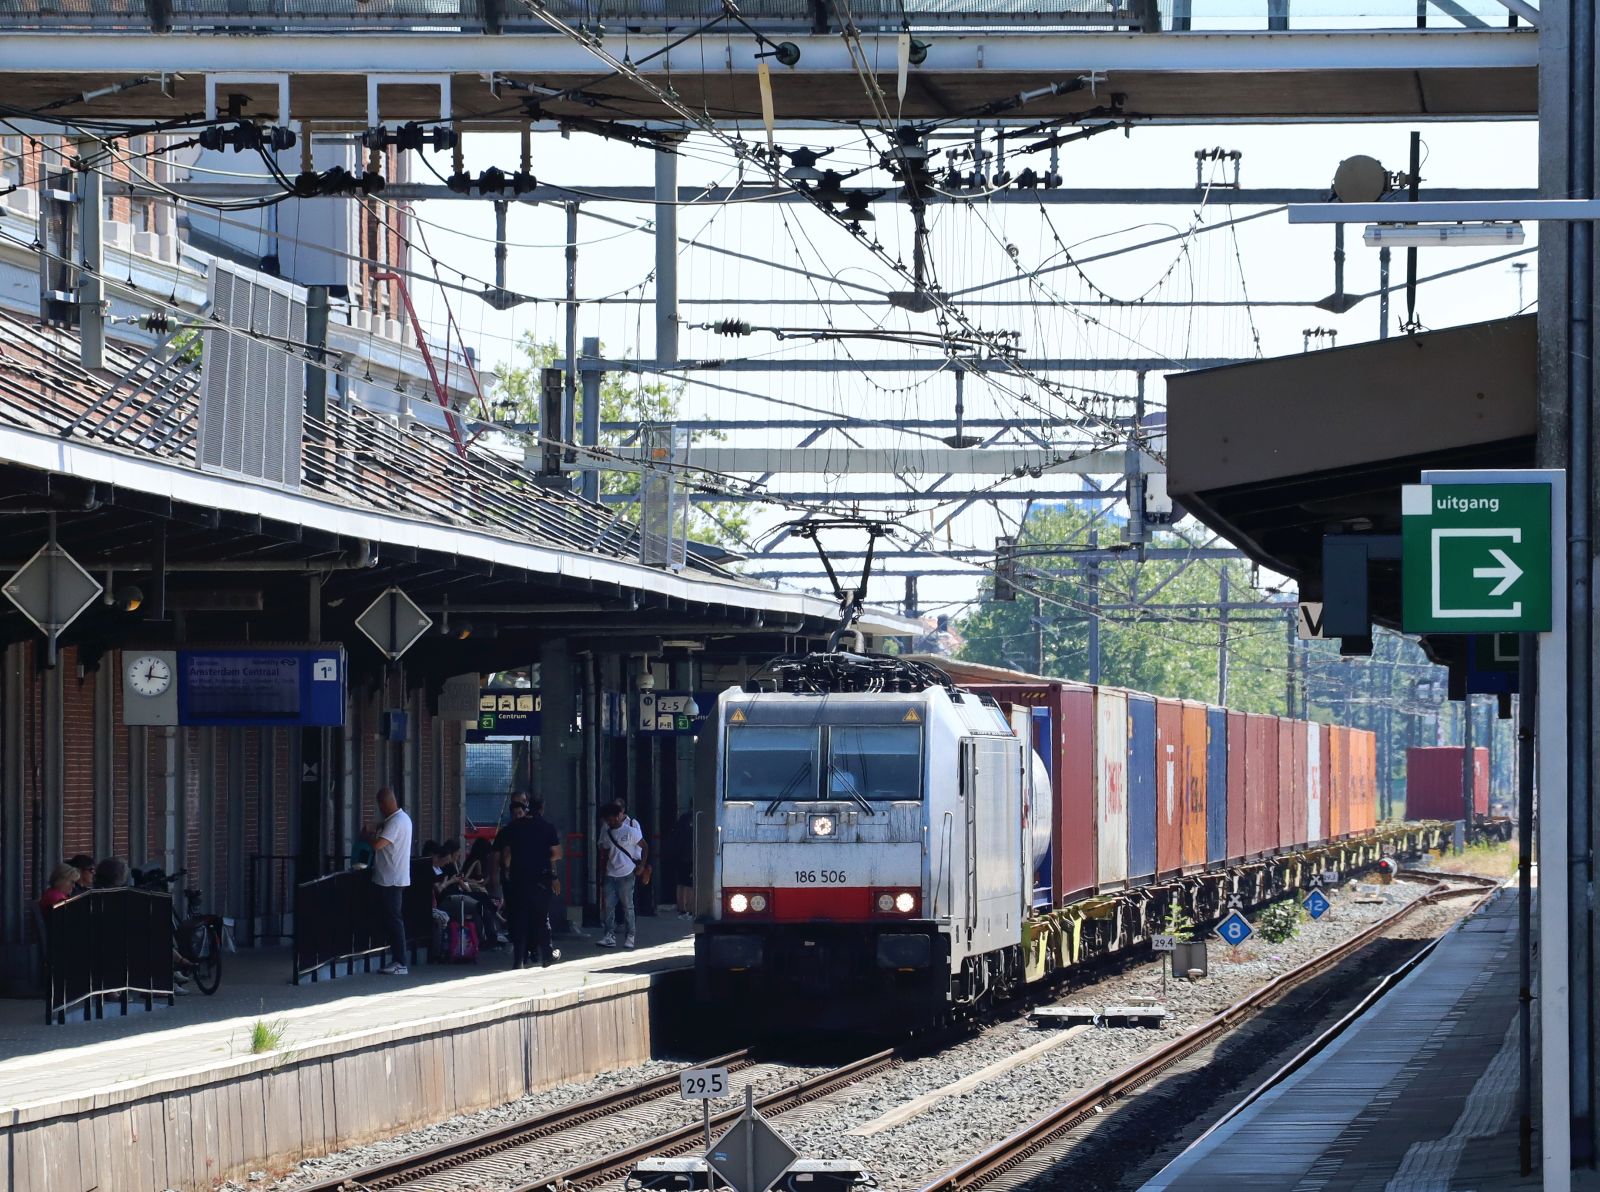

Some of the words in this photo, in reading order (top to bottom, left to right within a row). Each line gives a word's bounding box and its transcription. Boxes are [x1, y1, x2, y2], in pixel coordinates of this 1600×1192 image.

[1436, 495, 1500, 512] uitgang
[189, 667, 240, 676] Amsterdam
[242, 667, 279, 676] Centraal
[795, 870, 816, 883] 186
[820, 870, 847, 883] 506
[1306, 899, 1323, 911] 12
[1228, 922, 1241, 939] 8
[1154, 937, 1174, 947] 29.4
[686, 1073, 723, 1094] 29.5
